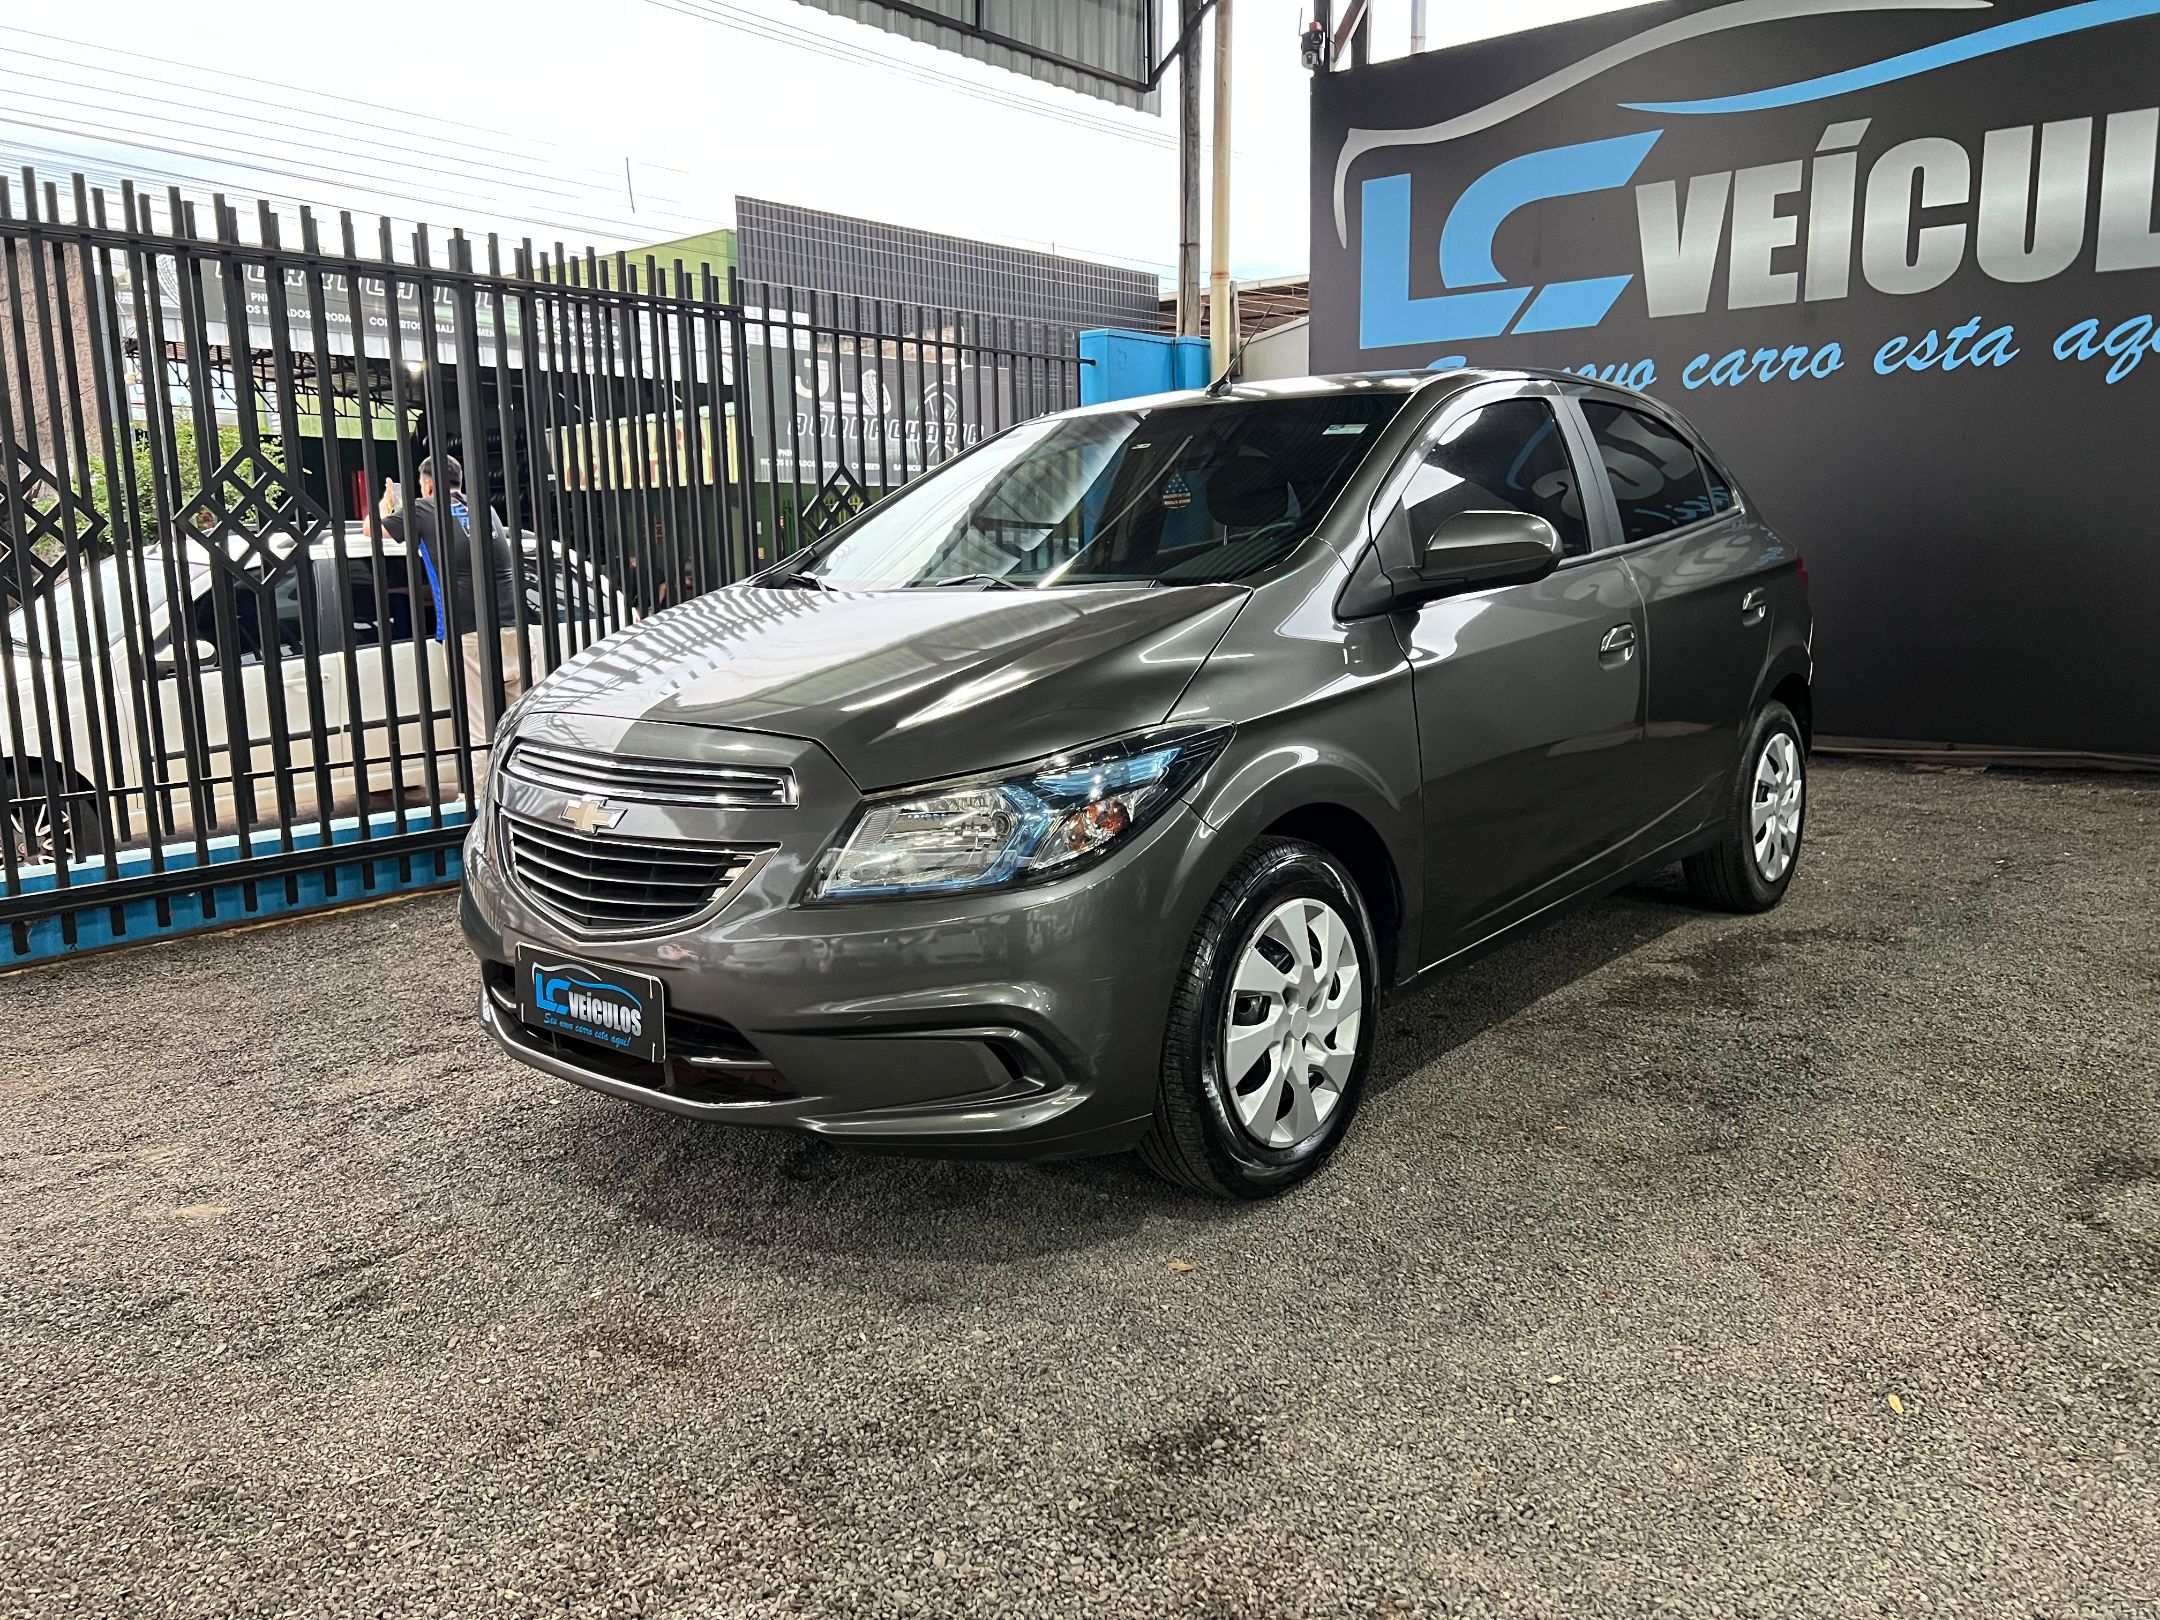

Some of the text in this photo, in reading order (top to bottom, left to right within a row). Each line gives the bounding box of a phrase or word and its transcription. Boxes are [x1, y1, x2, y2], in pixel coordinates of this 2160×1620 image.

[1359, 128, 1664, 350] LC
[1682, 343, 1845, 390] carro
[1872, 315, 2020, 375] esta
[2052, 313, 2160, 385] aq
[535, 972, 571, 1016] LC
[543, 1012, 557, 1025] Seu
